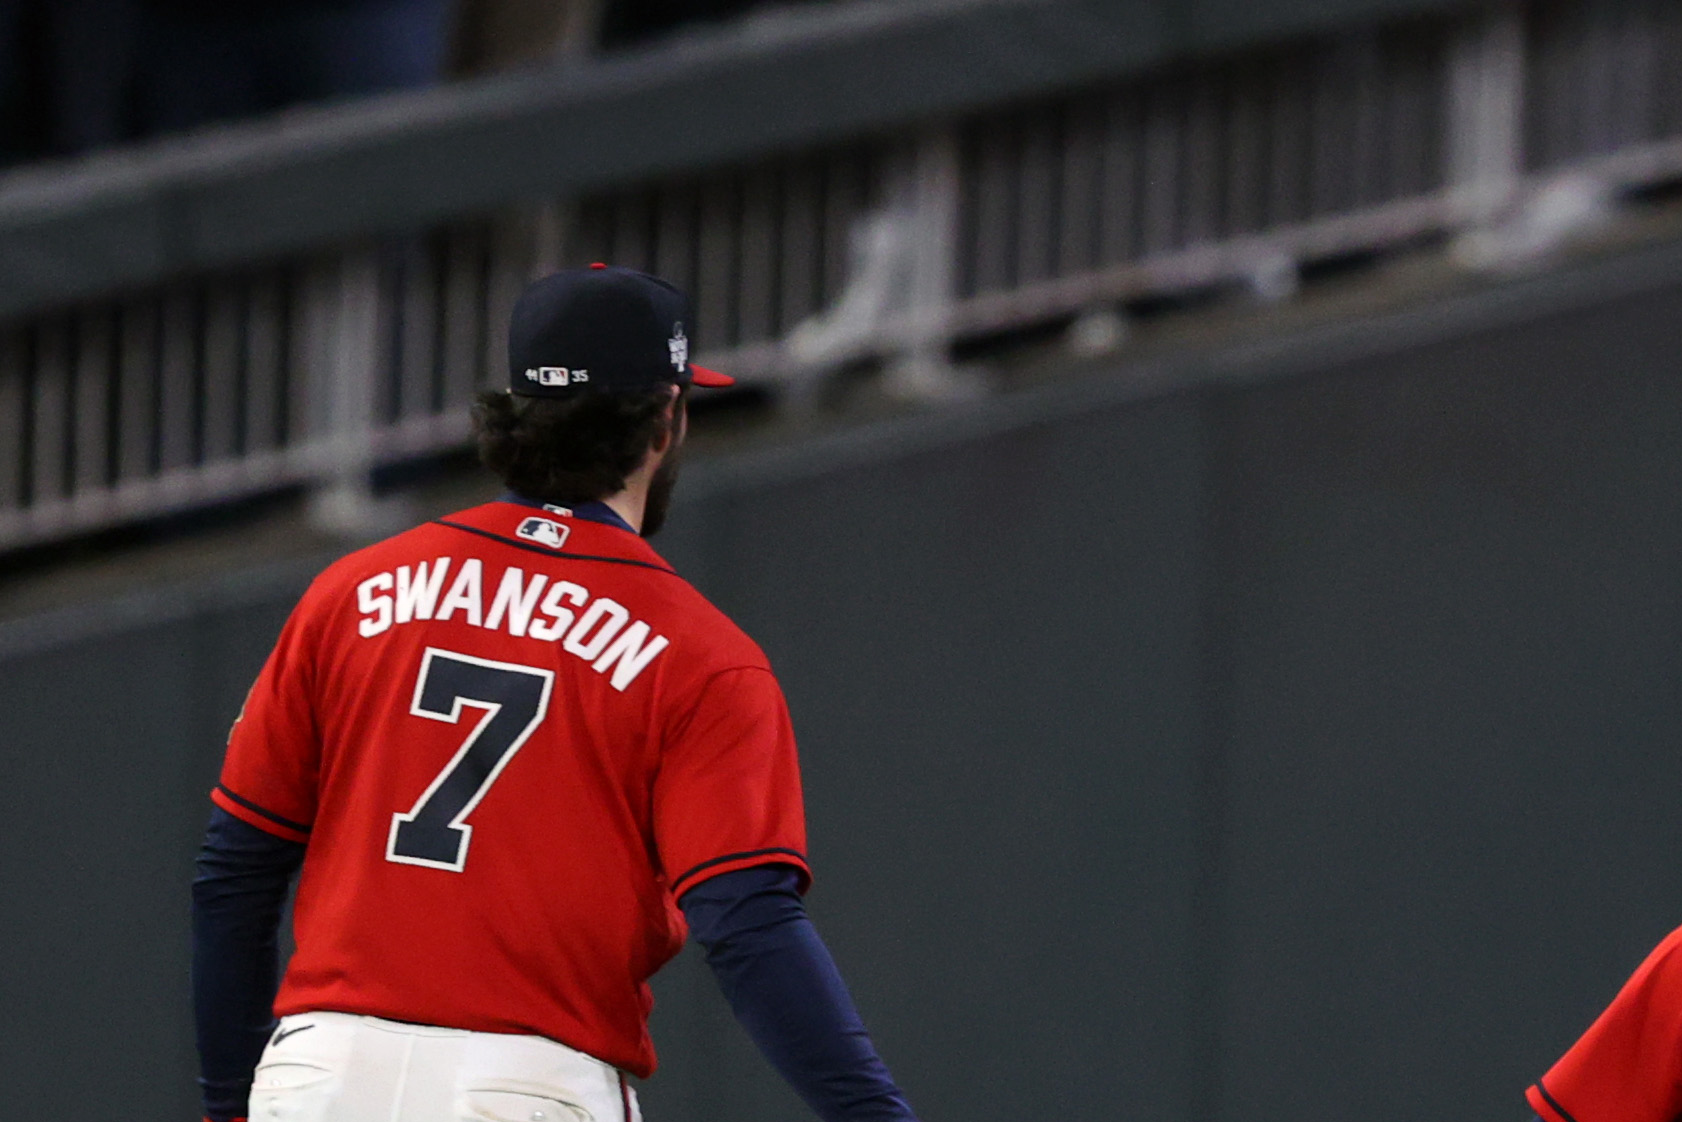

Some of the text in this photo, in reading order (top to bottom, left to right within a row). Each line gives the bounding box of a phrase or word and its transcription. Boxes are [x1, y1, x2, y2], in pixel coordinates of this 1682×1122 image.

[571, 369, 589, 382] 35
[357, 556, 669, 692] SWANSON
[385, 647, 555, 873] 7
